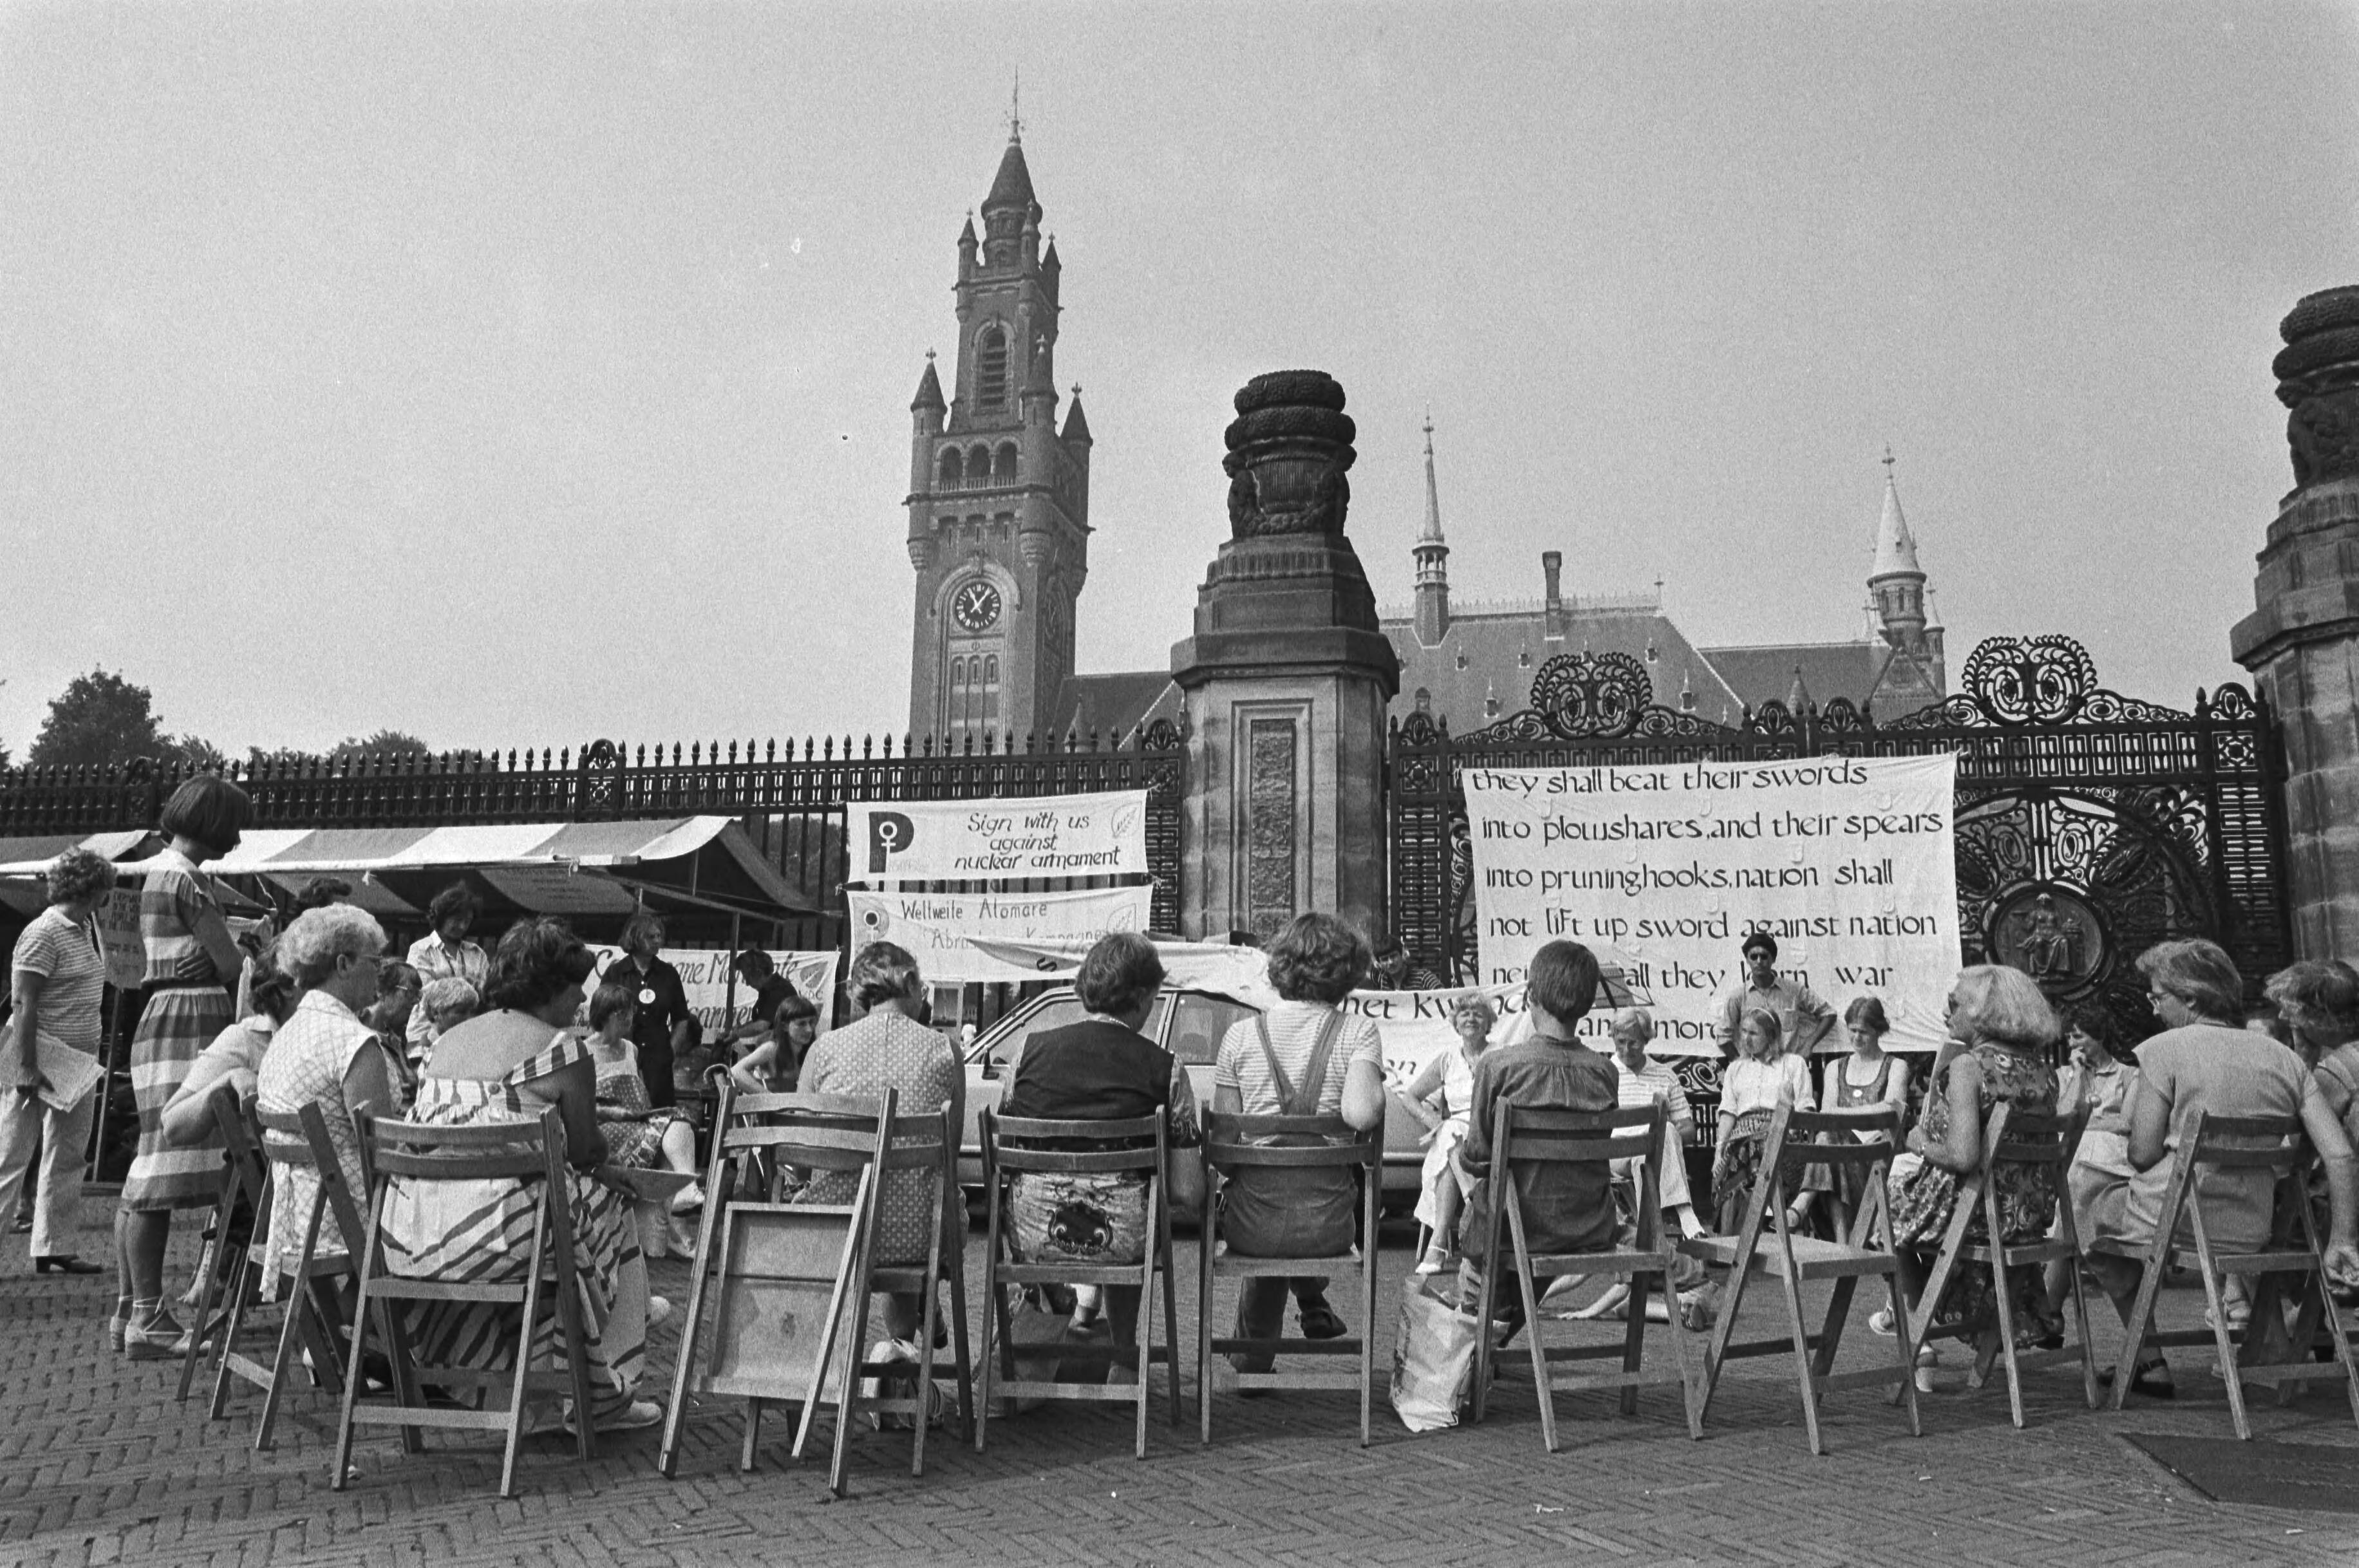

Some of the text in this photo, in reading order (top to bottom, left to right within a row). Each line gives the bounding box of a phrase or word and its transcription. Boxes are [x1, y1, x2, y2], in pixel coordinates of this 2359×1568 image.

[1472, 759, 1867, 799] they shall beat their swords
[968, 812, 1089, 836] Sign with us
[1483, 817, 1530, 839] into
[1772, 810, 1837, 837] their
[1844, 814, 1942, 841] spears
[954, 845, 1120, 870] nuclear armament
[990, 834, 1058, 855] against
[1487, 868, 1532, 887] into
[1835, 859, 1893, 885] shall
[901, 898, 1049, 920] Weltweite Atomare
[1491, 908, 1936, 942] not lift up sword against nation
[1662, 961, 1725, 996] they
[1835, 967, 1893, 986] war
[1579, 1017, 1612, 1037] an
